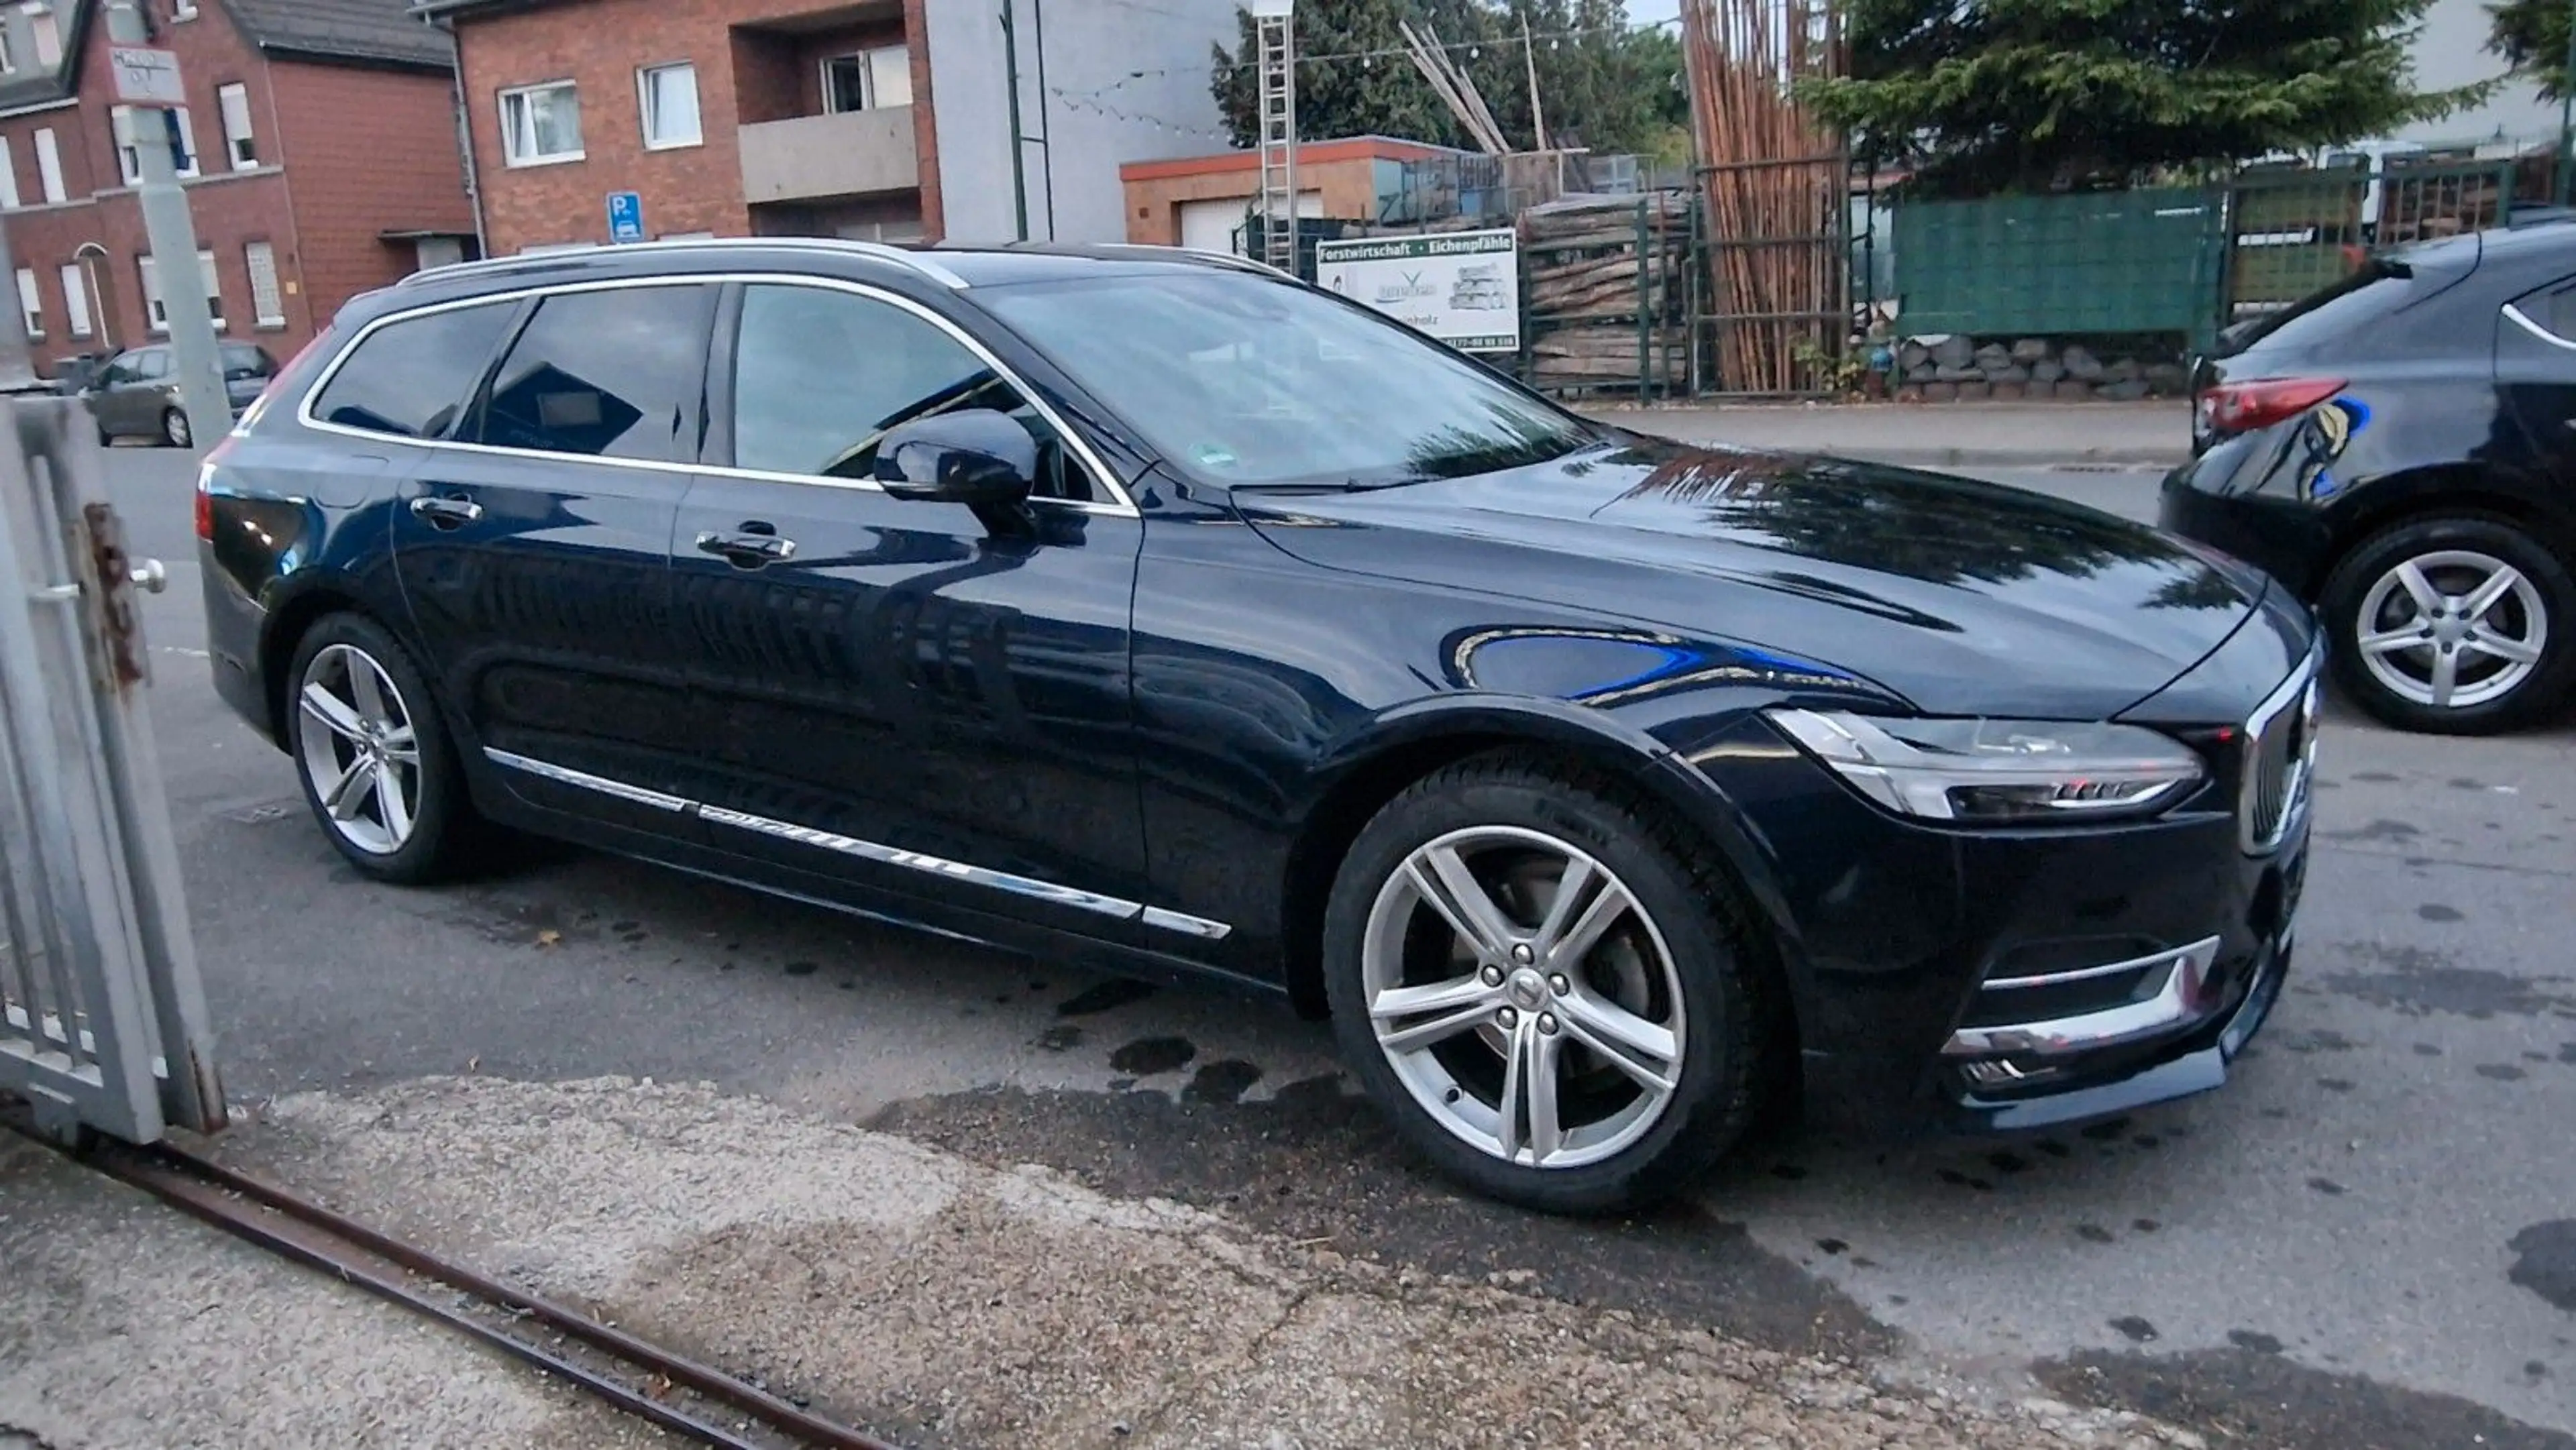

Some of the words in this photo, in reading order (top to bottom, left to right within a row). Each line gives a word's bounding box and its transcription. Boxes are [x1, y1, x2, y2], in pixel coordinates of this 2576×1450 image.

[612, 196, 627, 217] P
[1320, 242, 1411, 261] Forstwirtschaft
[1429, 235, 1511, 255] Eichenpfähle
